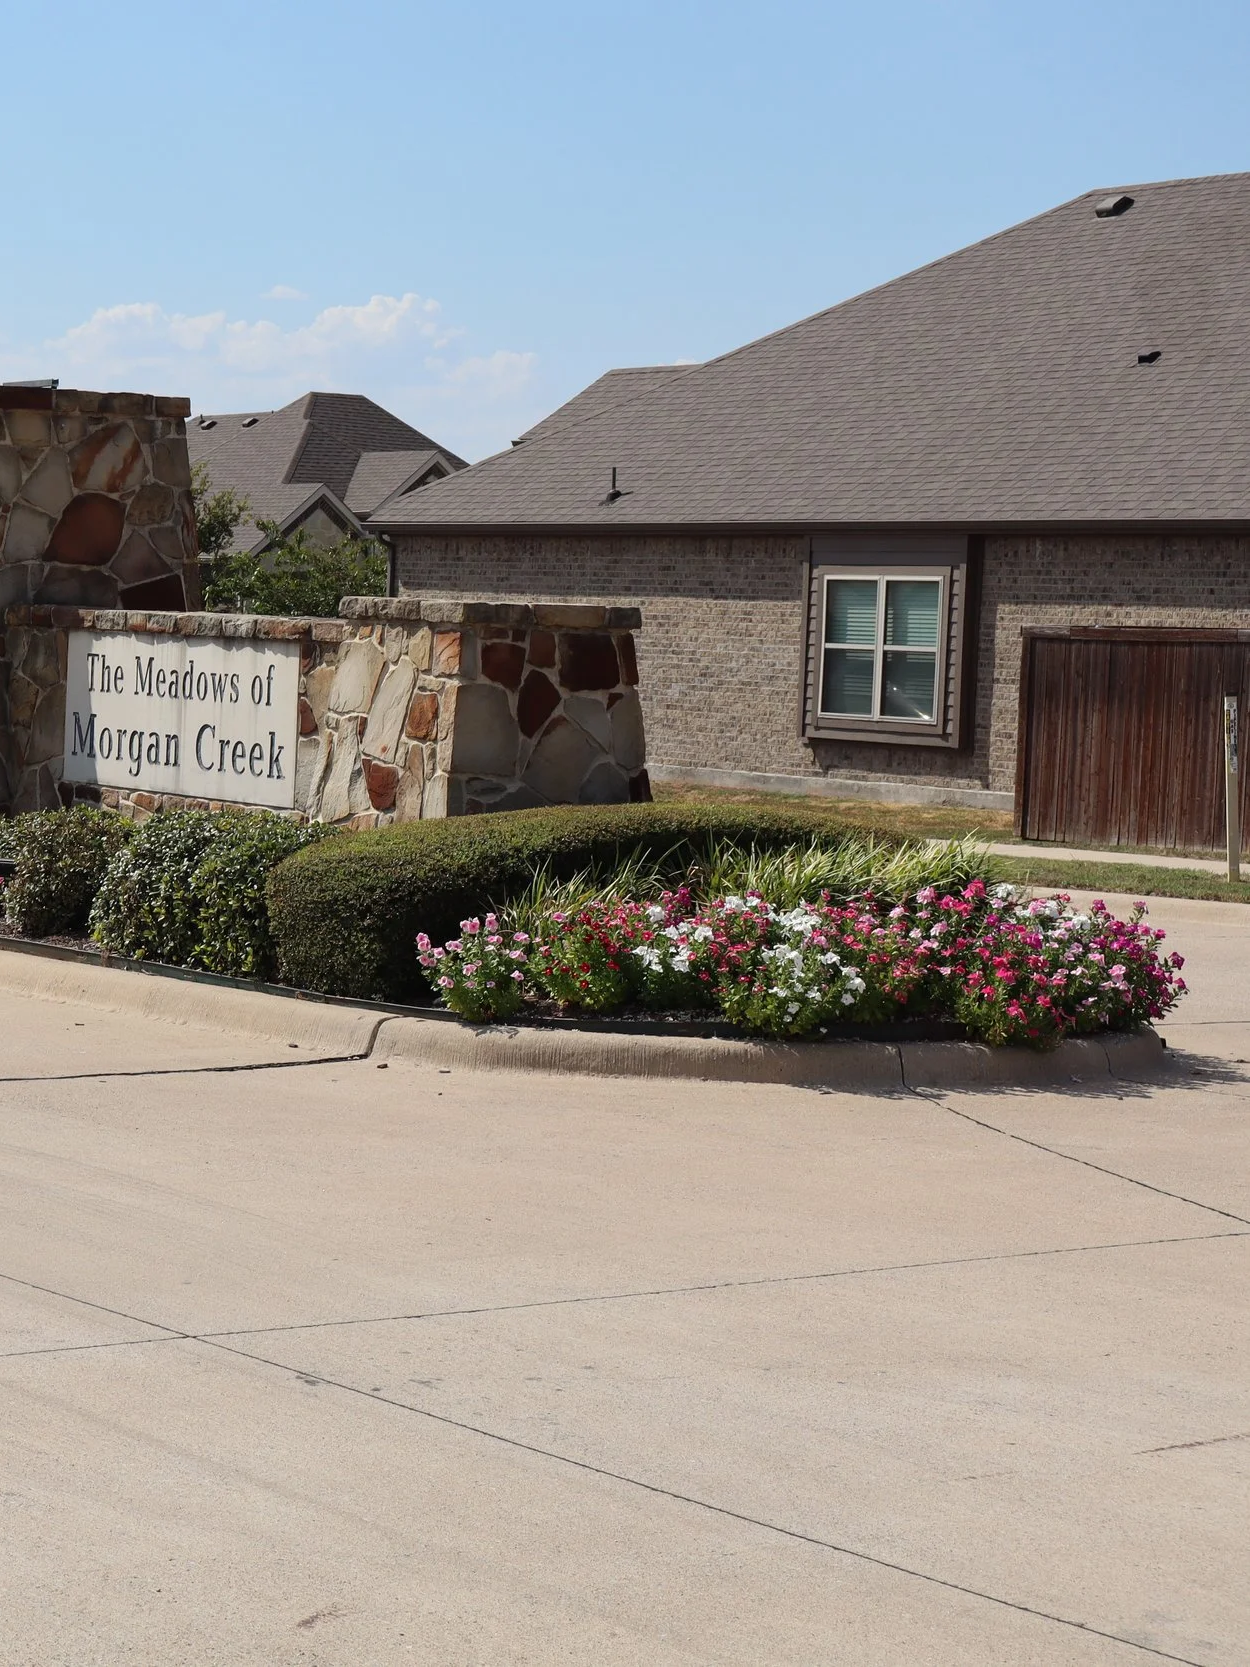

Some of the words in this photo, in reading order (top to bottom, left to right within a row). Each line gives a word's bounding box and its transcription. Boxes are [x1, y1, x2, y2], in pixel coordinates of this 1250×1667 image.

[87, 653, 124, 694] The
[134, 655, 240, 704] Meadows
[250, 664, 276, 707] of
[71, 712, 180, 777] Morgan
[195, 724, 285, 780] Creek
